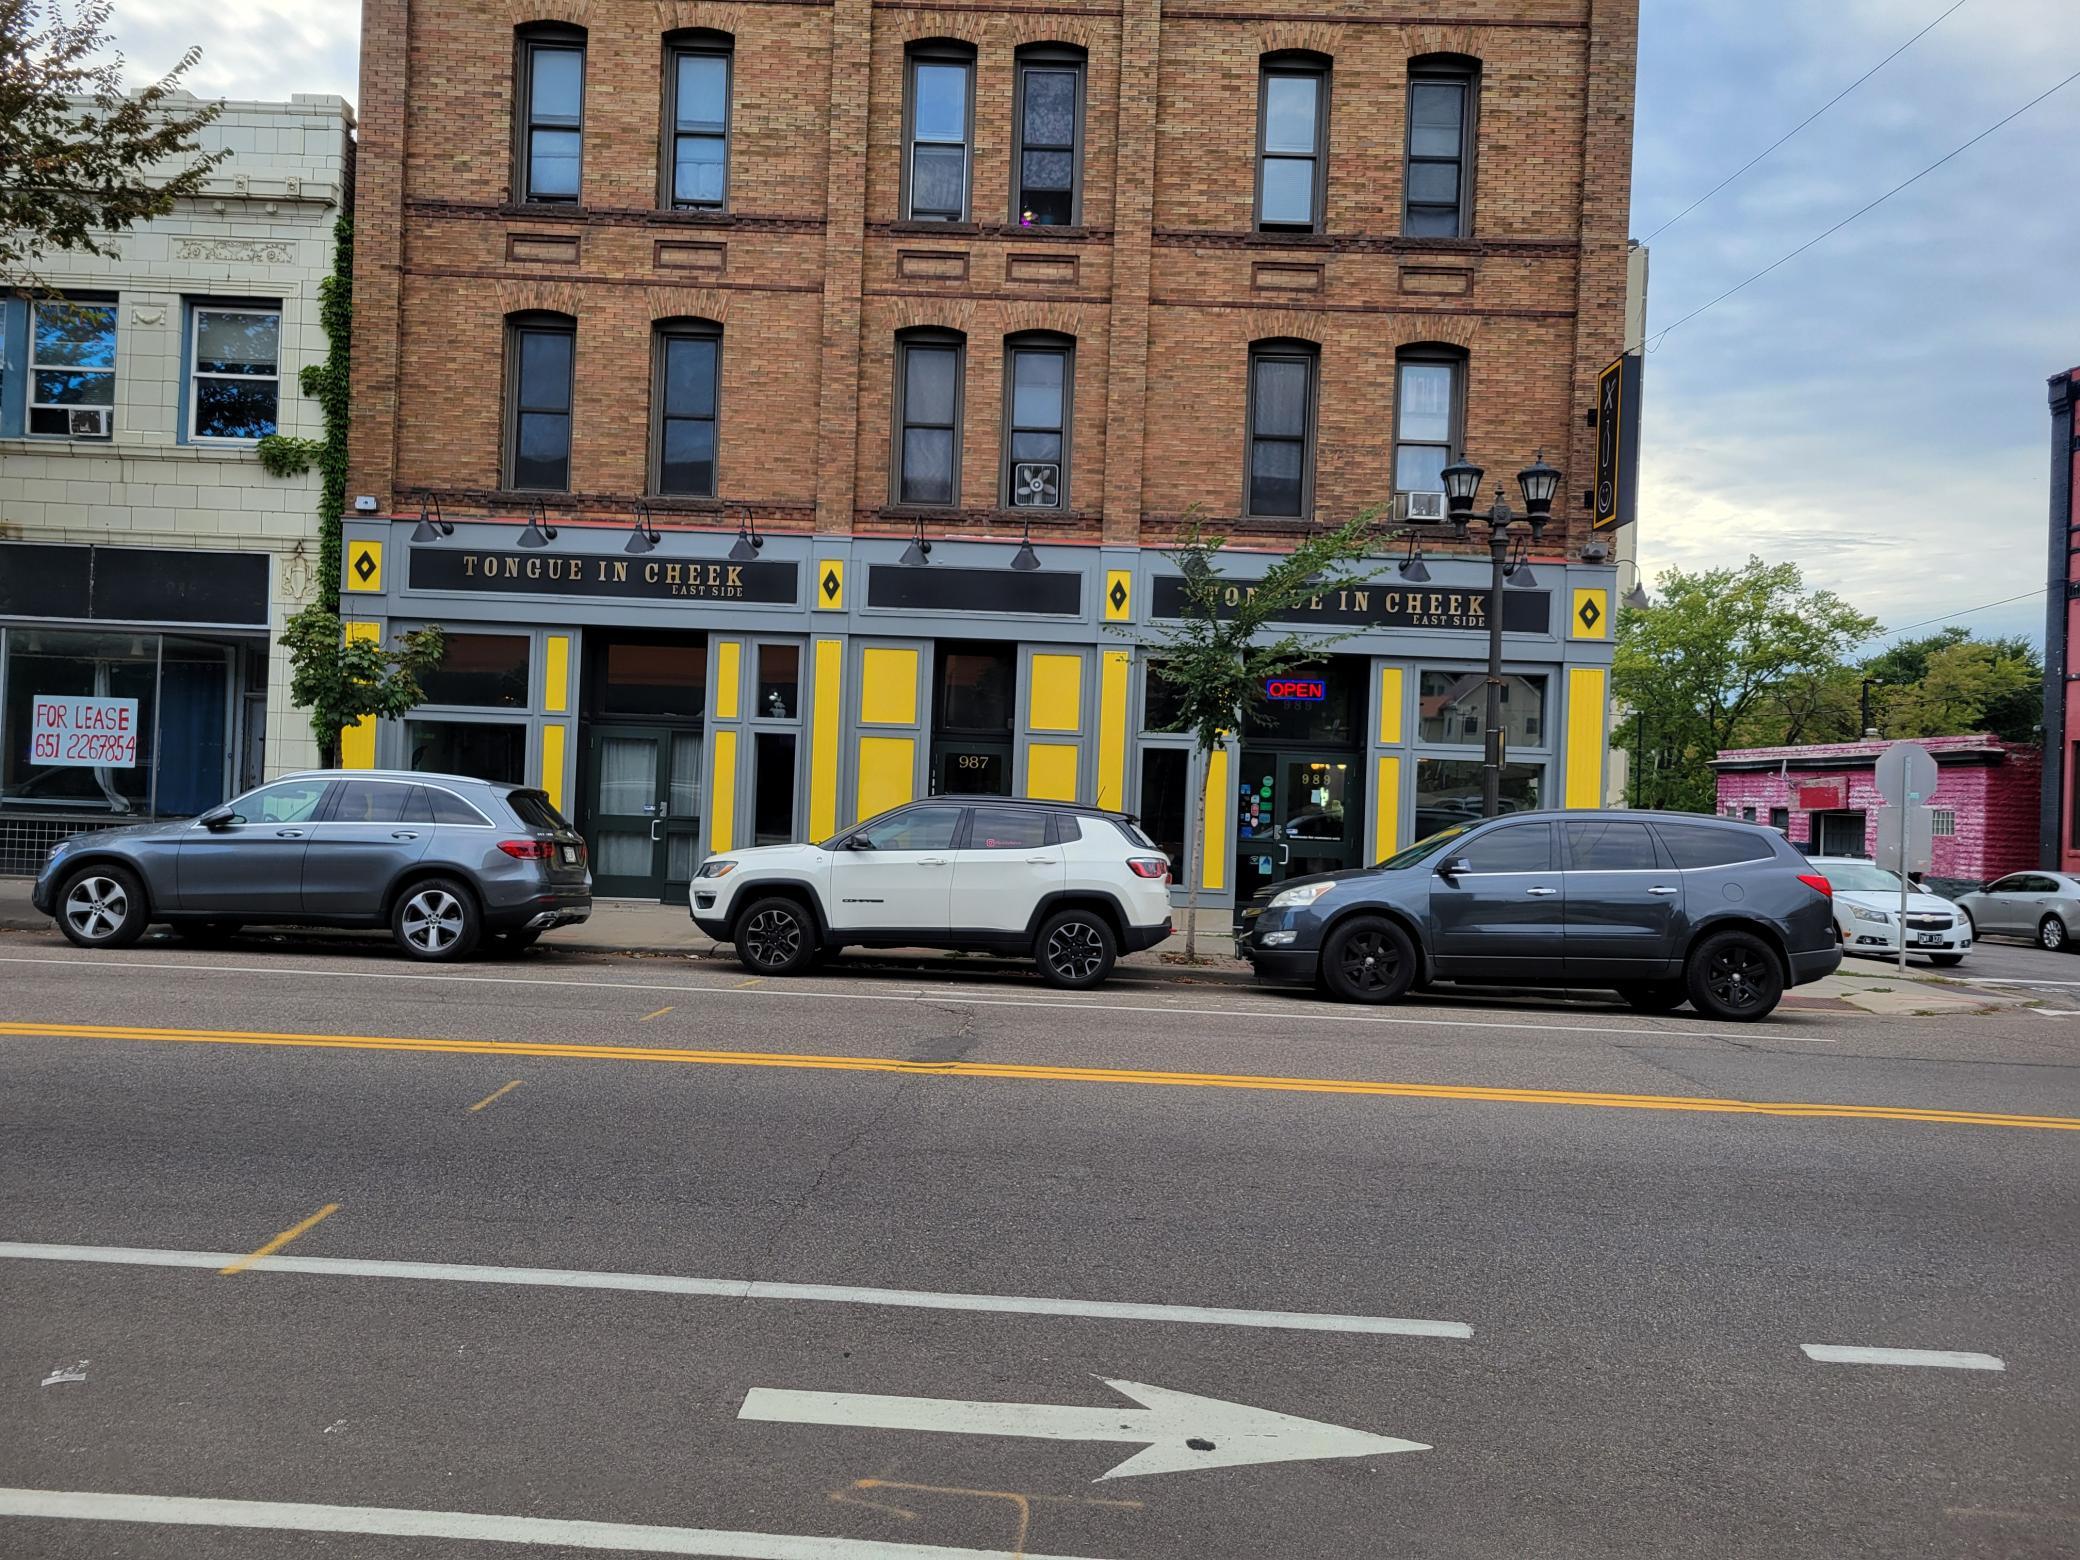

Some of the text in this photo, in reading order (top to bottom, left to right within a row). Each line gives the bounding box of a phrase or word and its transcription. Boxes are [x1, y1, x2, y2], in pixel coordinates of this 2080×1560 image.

[463, 556, 743, 586] TONGUE IN CHEEK
[672, 584, 743, 598] EAST SIDE
[1338, 590, 1370, 611] IN
[1385, 592, 1485, 616] CHEEK
[1413, 614, 1485, 627] EAST SIDE
[1269, 682, 1322, 698] OPEN
[37, 704, 129, 730] FOR LEASE
[35, 733, 136, 762] 651 2267854
[959, 755, 989, 769] 987
[1302, 774, 1331, 785] 989
